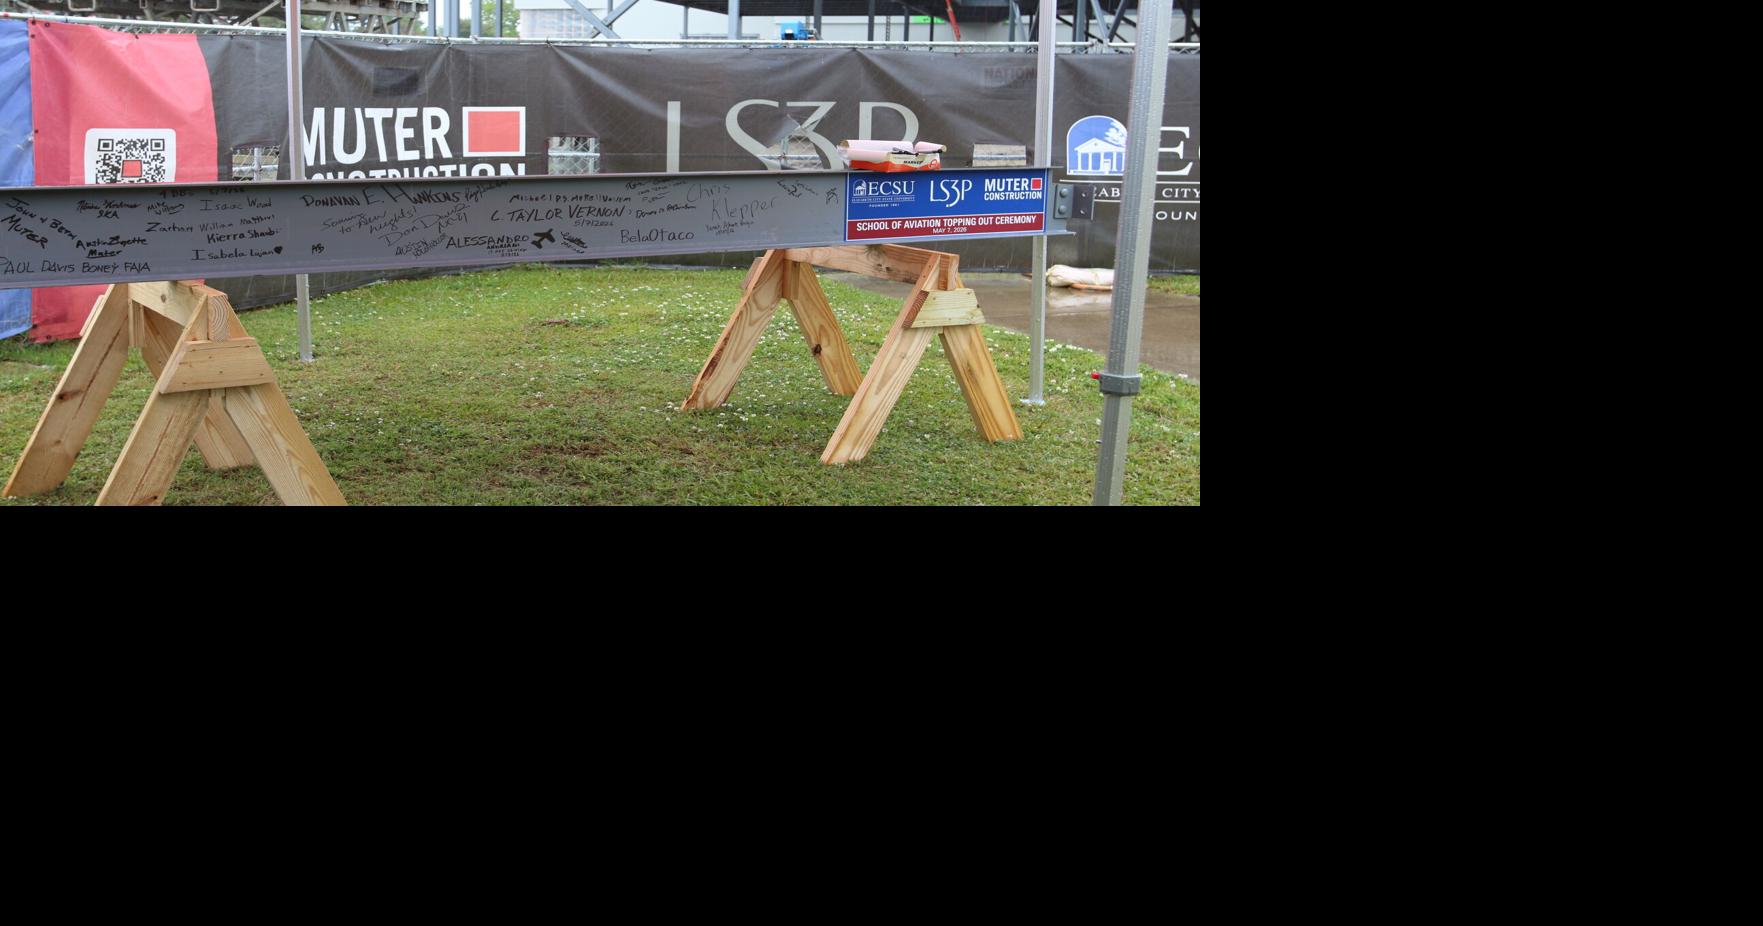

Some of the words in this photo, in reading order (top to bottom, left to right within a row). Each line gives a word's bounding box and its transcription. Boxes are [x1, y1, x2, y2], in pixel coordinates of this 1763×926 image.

[984, 67, 1038, 80] NATION
[303, 107, 453, 167] MUTER
[1156, 126, 1200, 176] E
[868, 181, 916, 196] ECSU
[984, 178, 1029, 192] MUTER
[687, 183, 731, 203] Chris
[930, 179, 973, 208] LS3P
[984, 191, 1043, 201] CONSTRUCTION
[1162, 188, 1200, 198] CITY
[507, 208, 563, 222] TAYLOR
[568, 205, 626, 219] VERNON
[1155, 211, 1198, 221] OUN
[856, 221, 890, 231] SCHOOL
[891, 220, 902, 230] OF
[903, 218, 942, 229] AVIATION
[943, 217, 977, 227] TOPPING
[978, 216, 994, 226] OUT
[995, 215, 1037, 225] CEREMONY
[446, 235, 530, 249] ALESSANDRO
[41, 260, 76, 273] DAVIS
